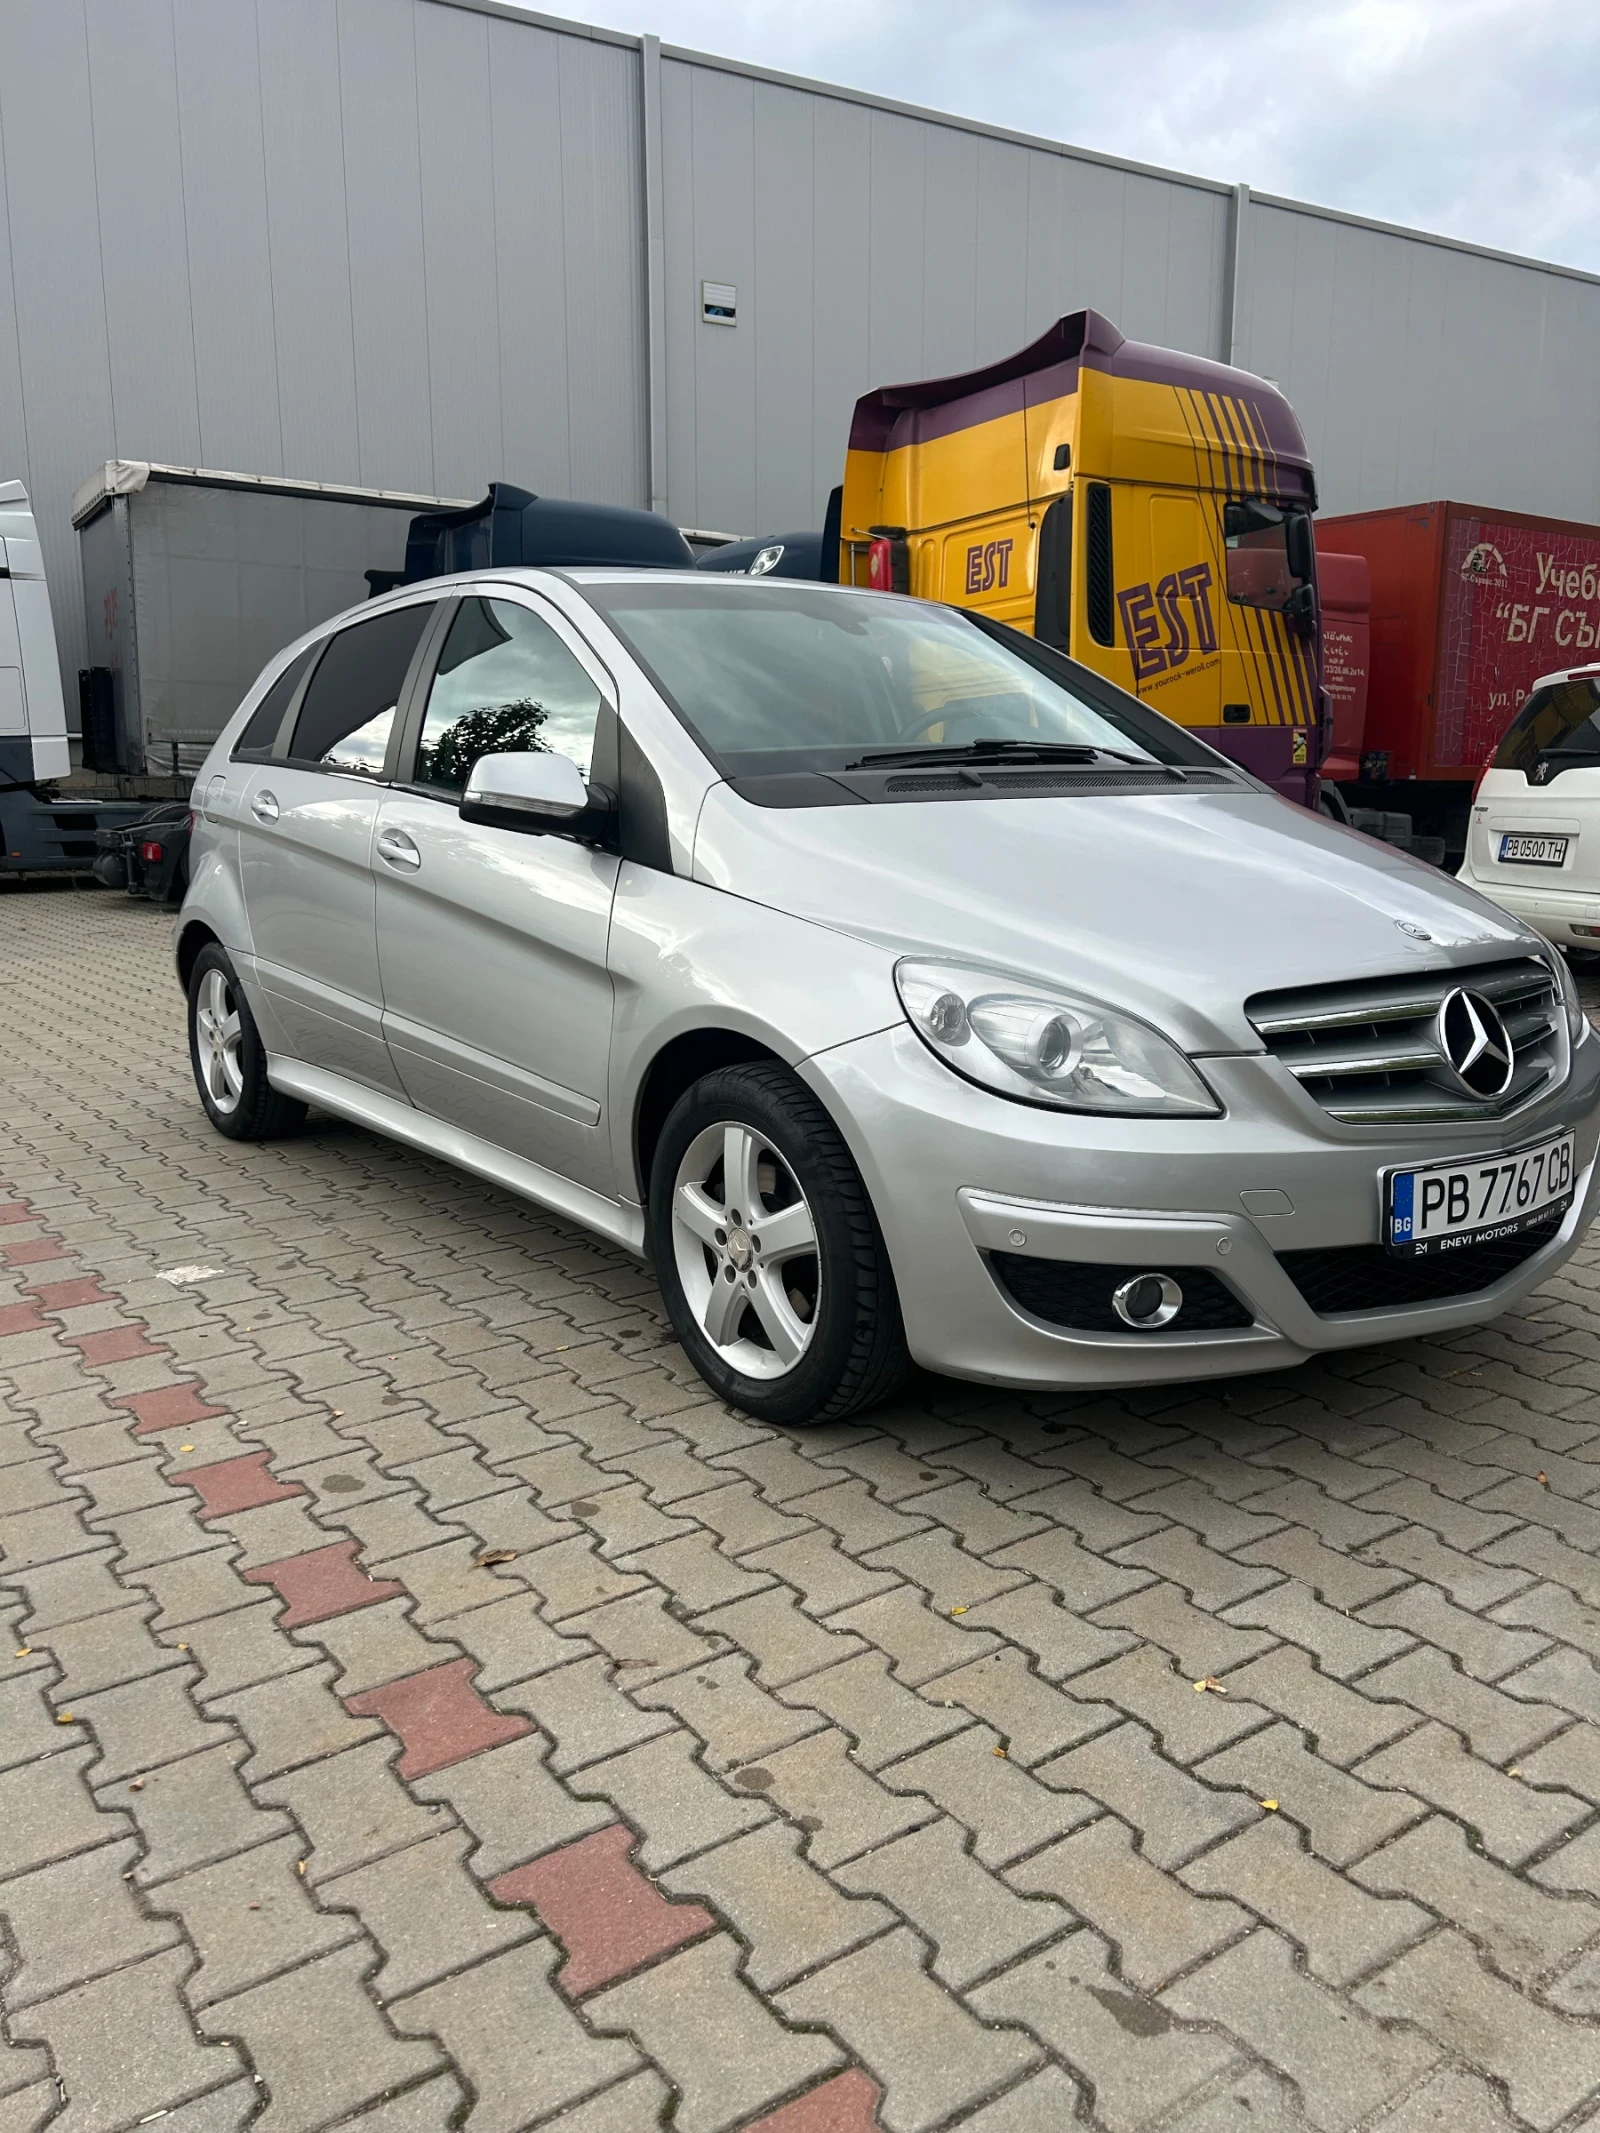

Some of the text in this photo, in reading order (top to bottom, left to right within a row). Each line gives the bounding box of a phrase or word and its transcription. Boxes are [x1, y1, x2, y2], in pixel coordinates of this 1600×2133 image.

[966, 539, 1013, 595] EST
[1536, 552, 1600, 600] Учеб
[1116, 561, 1217, 681] EST
[1135, 658, 1220, 695] www.yourock-weroll.com
[1488, 692, 1510, 710] ул.
[1506, 839, 1563, 860] PB 0500 TH
[1421, 1141, 1570, 1230] PB 7767 CB
[1394, 1217, 1411, 1234] BG
[1440, 1234, 1472, 1250] ENEVI
[1475, 1222, 1519, 1243] MOTORS
